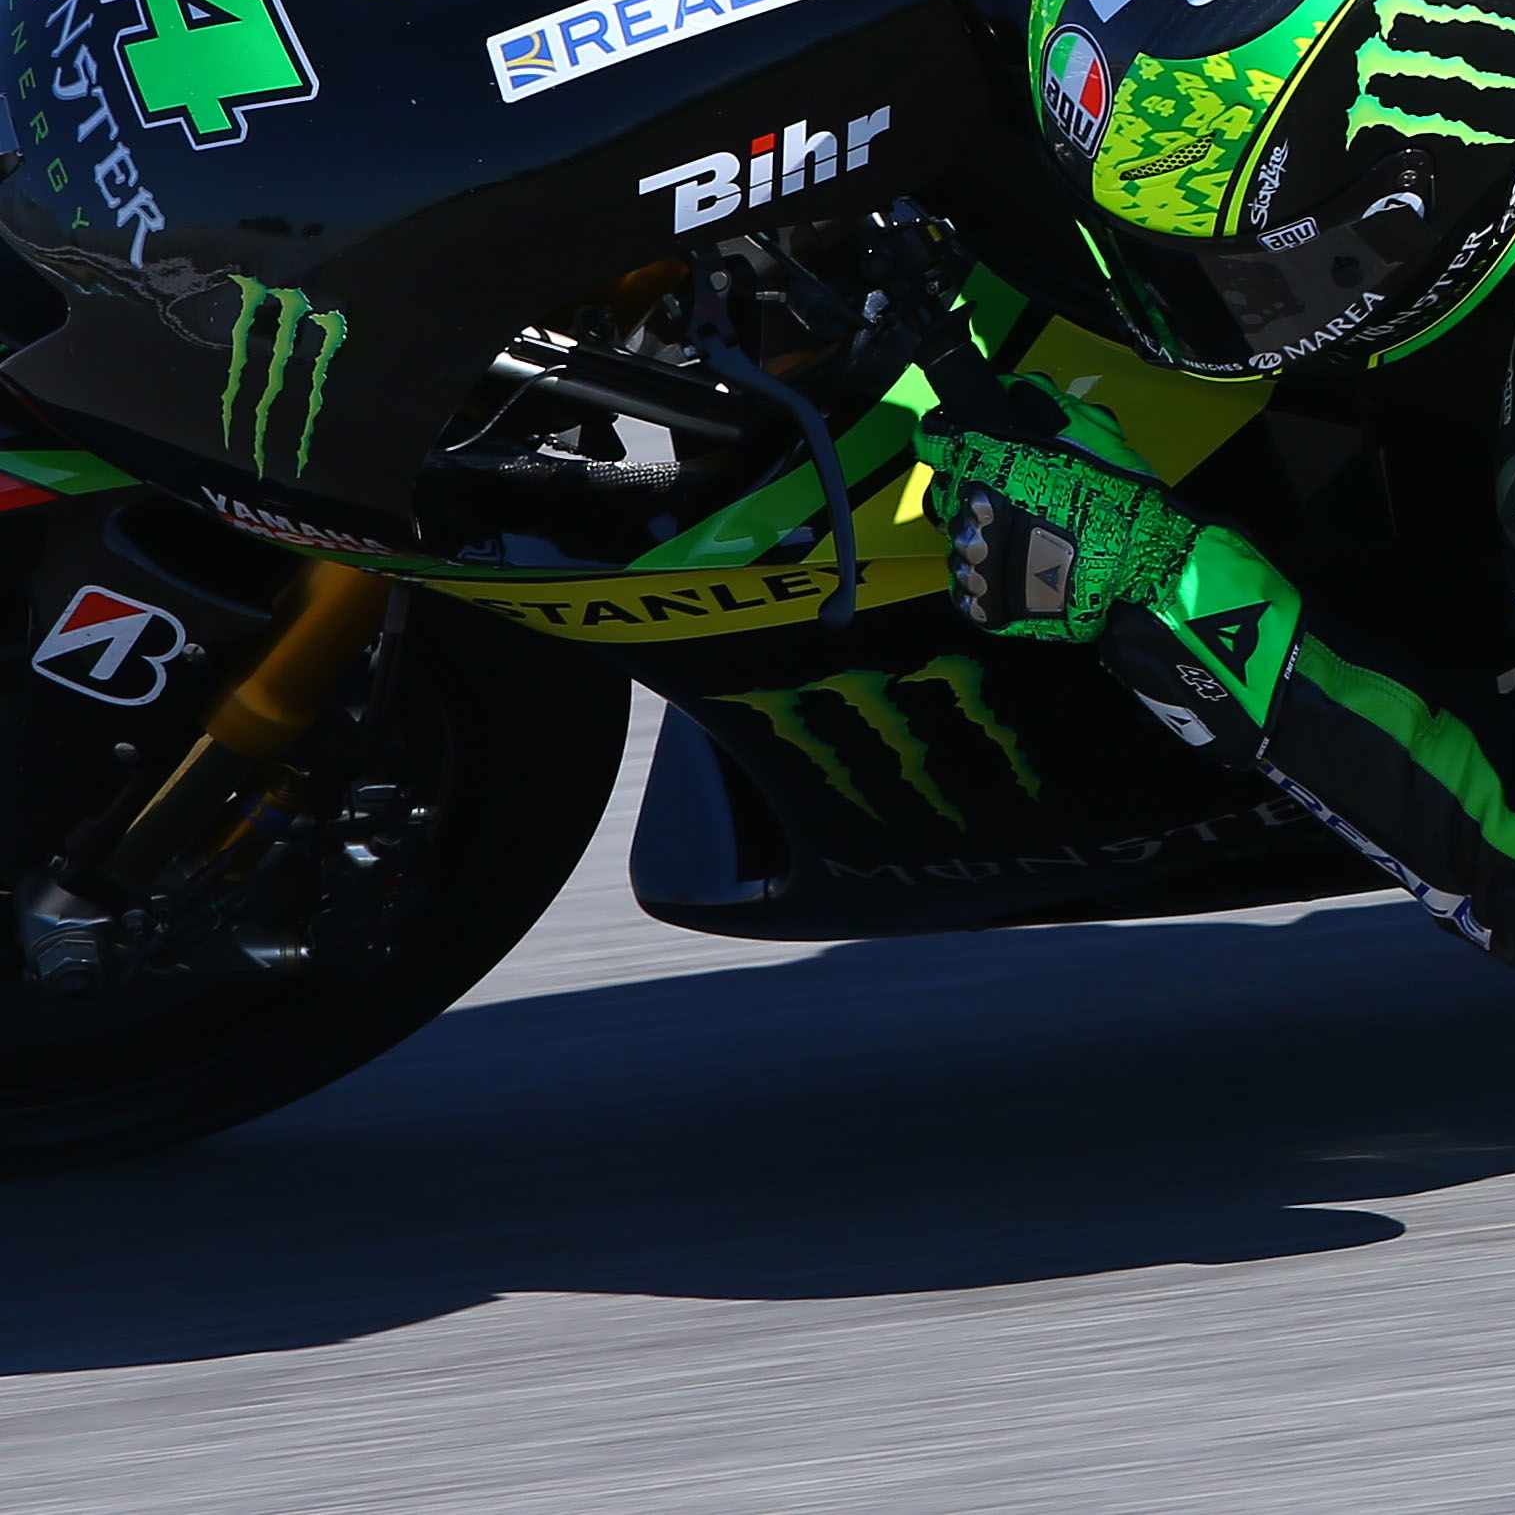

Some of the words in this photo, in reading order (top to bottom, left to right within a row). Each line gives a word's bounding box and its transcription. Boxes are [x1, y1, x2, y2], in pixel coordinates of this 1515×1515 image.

[638, 105, 892, 235] Bihr
[1284, 291, 1387, 361] MAREA
[1176, 663, 1229, 702] 44
[819, 796, 1308, 885] MONSTE
